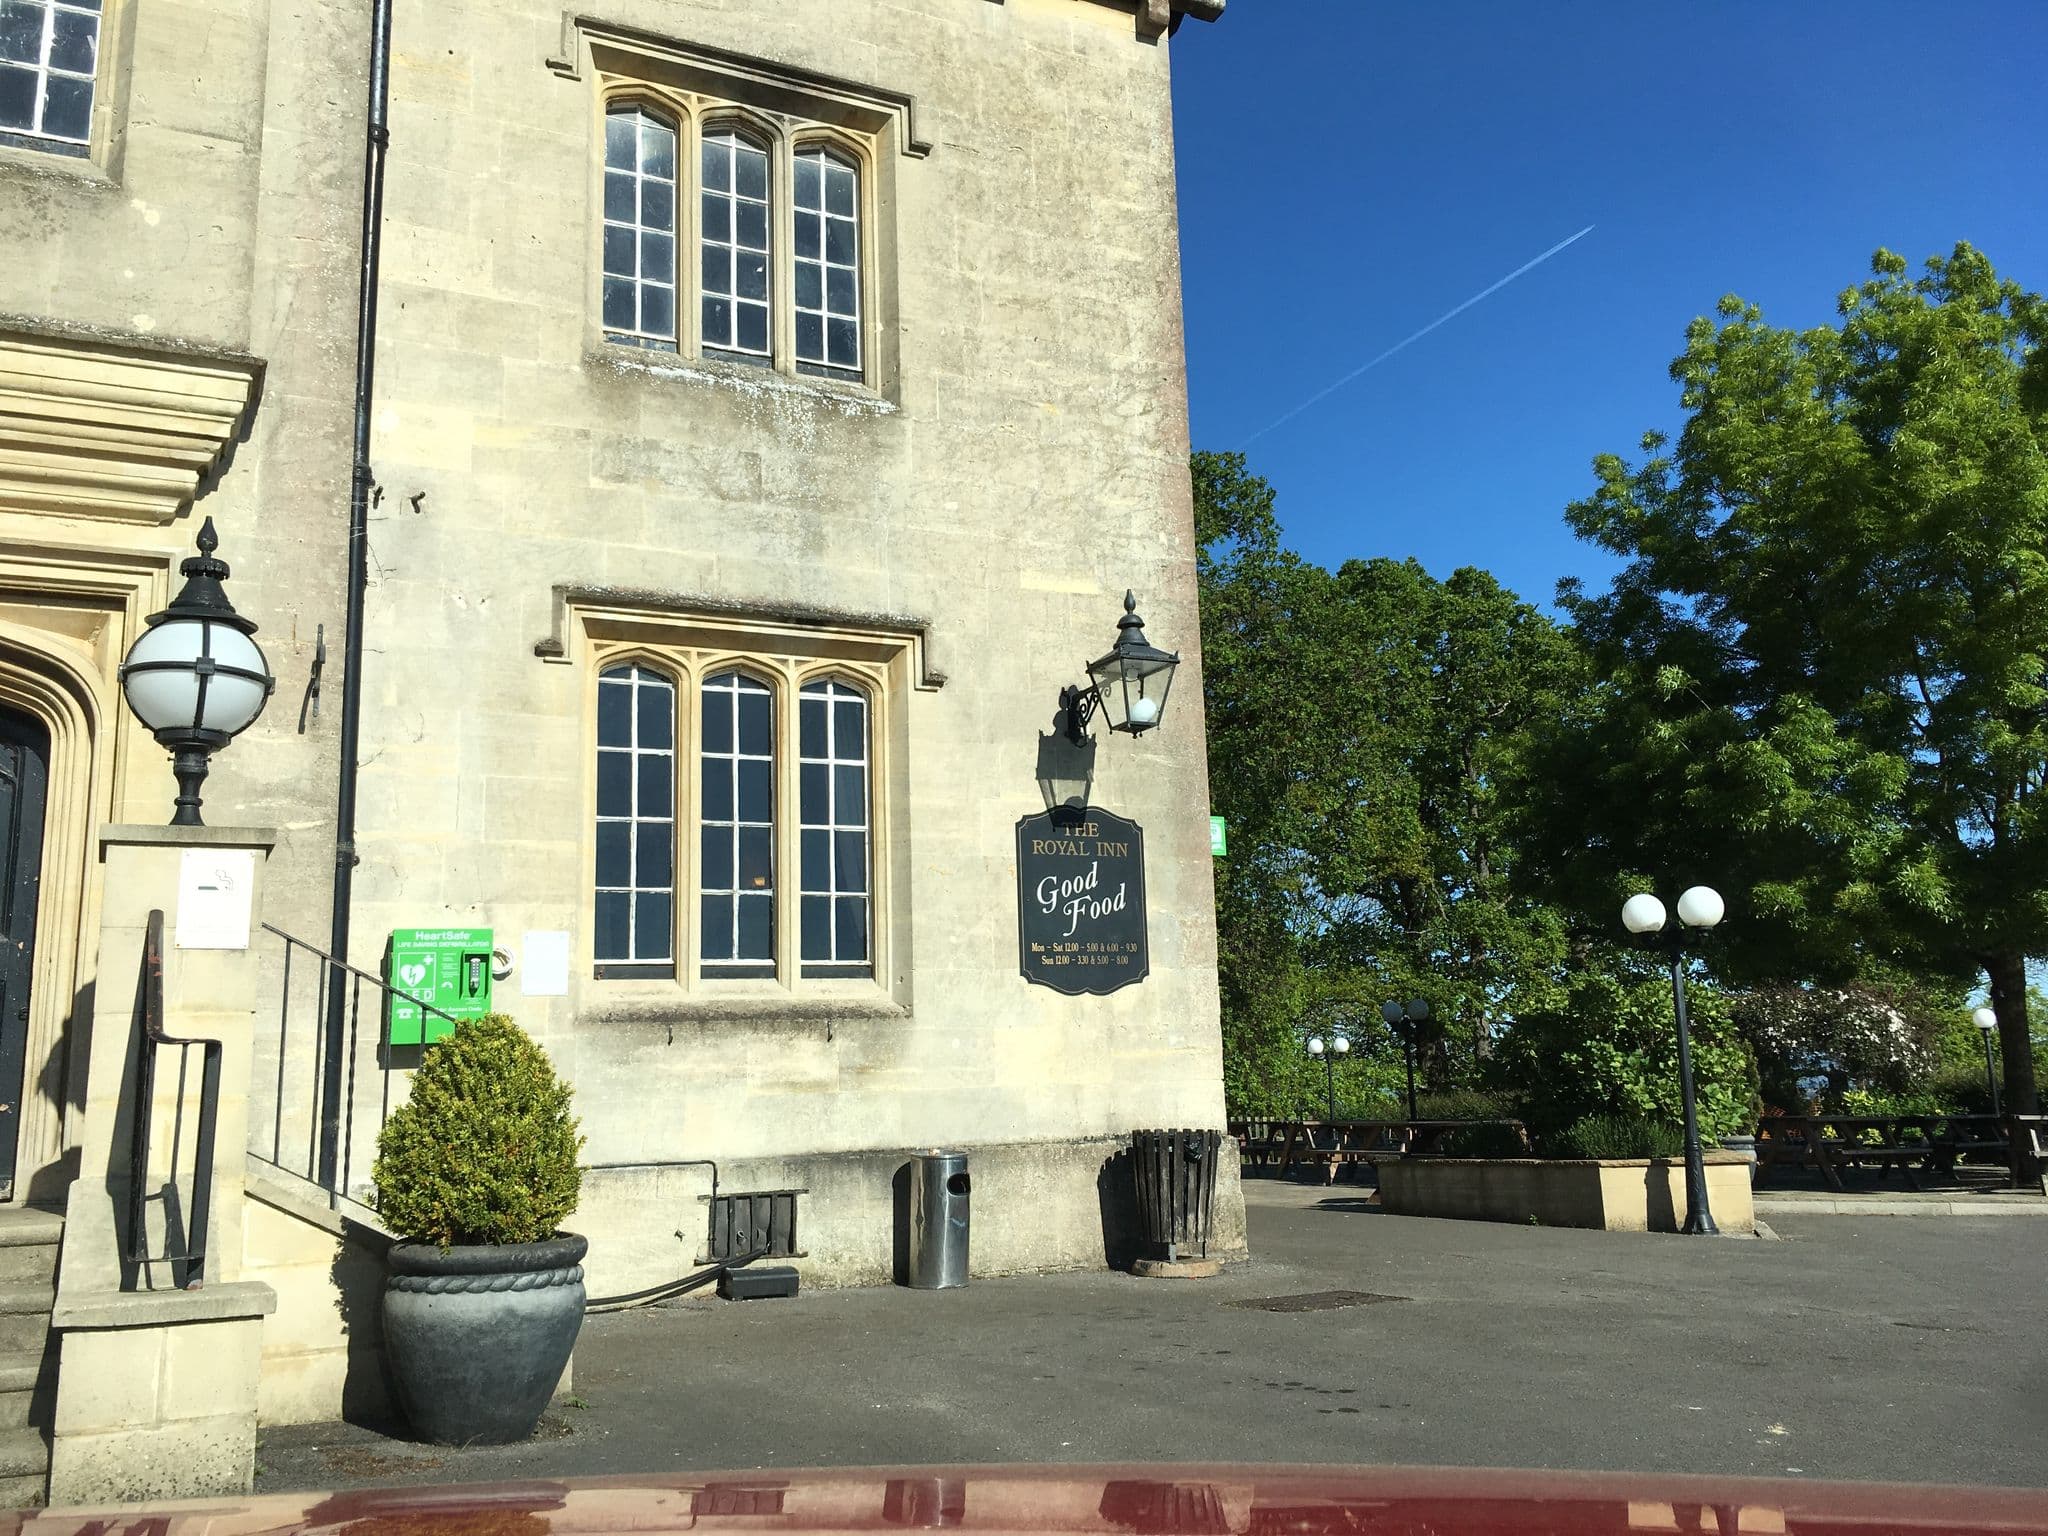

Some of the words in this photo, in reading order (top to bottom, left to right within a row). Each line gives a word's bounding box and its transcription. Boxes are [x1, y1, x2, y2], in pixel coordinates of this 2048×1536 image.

[1063, 822, 1100, 837] THE
[1032, 839, 1090, 856] ROYAL
[1096, 842, 1128, 857] INN
[1036, 861, 1098, 914] Good
[1062, 882, 1126, 937] Food
[415, 931, 471, 940] HeartSafe
[1031, 942, 1045, 952] Mon
[1053, 942, 1063, 952] Sat
[1064, 942, 1079, 952] 12.00
[1041, 955, 1054, 965] Sun
[1055, 955, 1070, 965] 12.00
